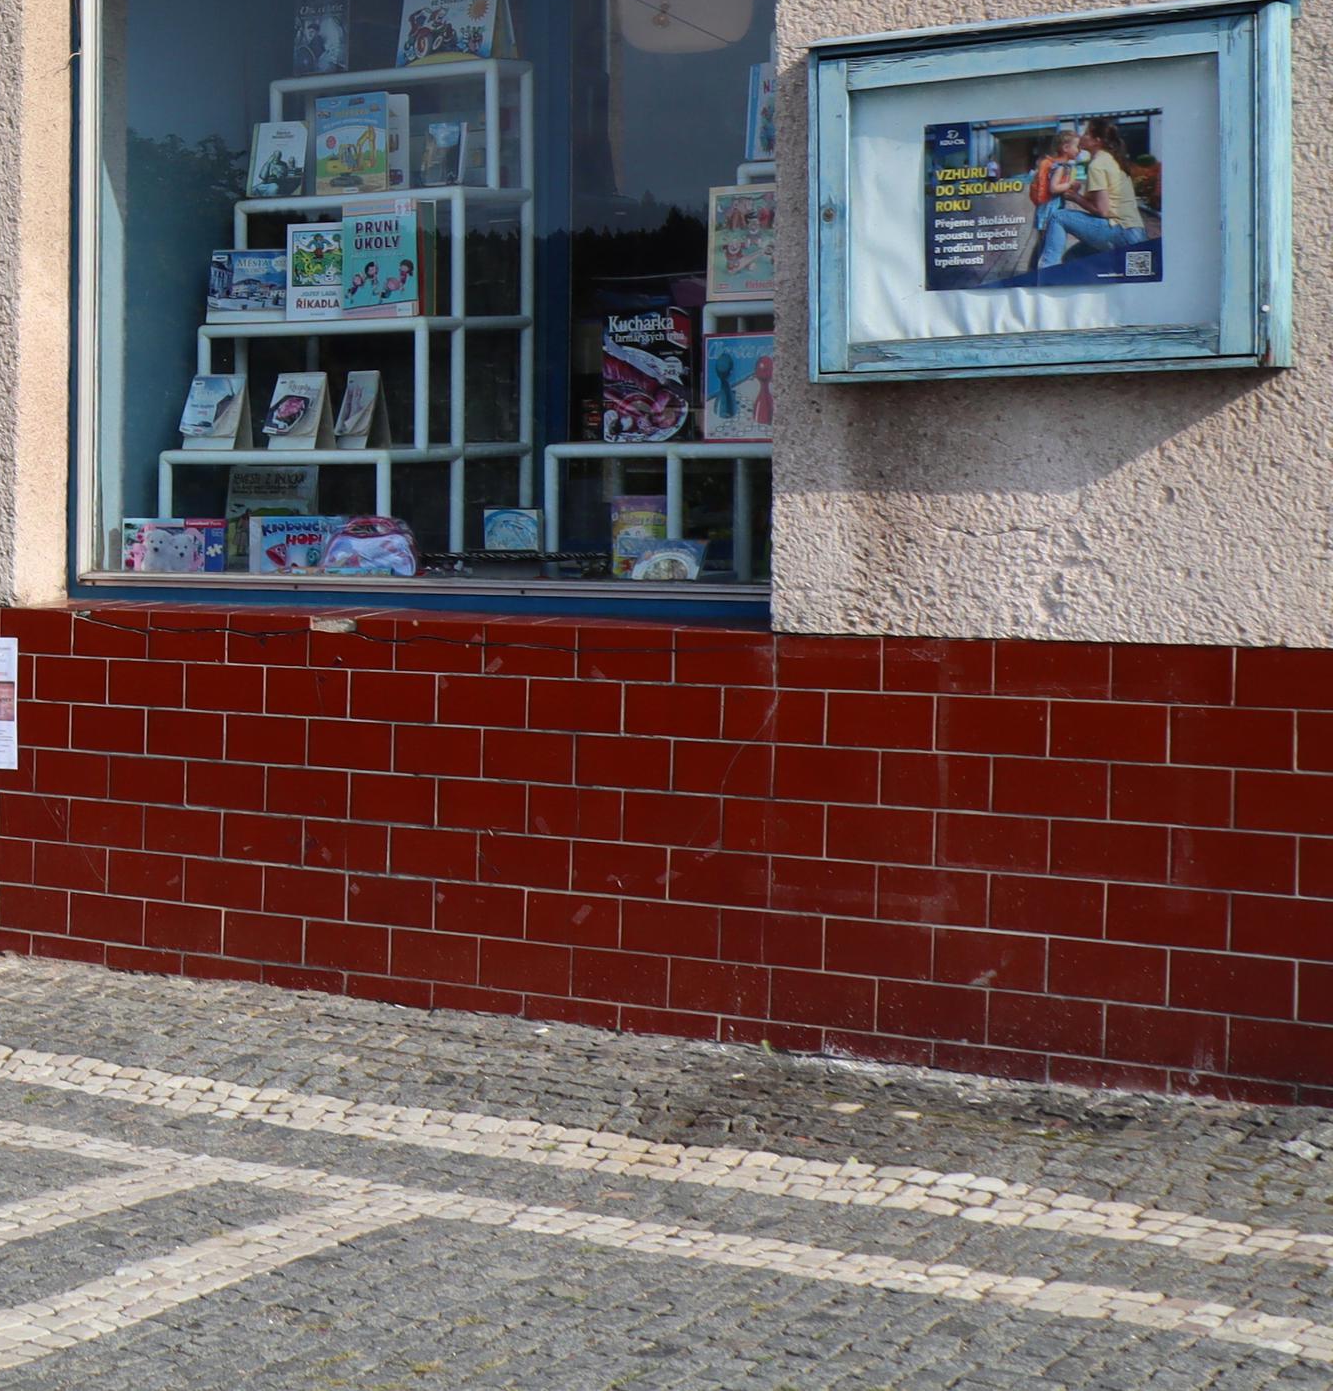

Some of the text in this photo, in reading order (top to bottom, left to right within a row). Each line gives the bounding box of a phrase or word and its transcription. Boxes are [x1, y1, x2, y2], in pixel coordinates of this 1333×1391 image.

[936, 165, 988, 181] VZHŮRU
[936, 179, 1023, 196] DO ŠKOLNÍHO
[936, 200, 971, 212] ROKU
[355, 216, 400, 234] PRVNÍ
[935, 214, 1026, 231] Přejeme školákům
[355, 234, 401, 250] ÚKOLY
[935, 227, 1018, 242] spoustu úspěchů
[943, 242, 984, 253] rodičům
[987, 240, 1018, 252] hodně
[935, 254, 984, 267] trpělivosti
[296, 297, 340, 309] ŘÍKADLA
[285, 534, 323, 546] HOP!
